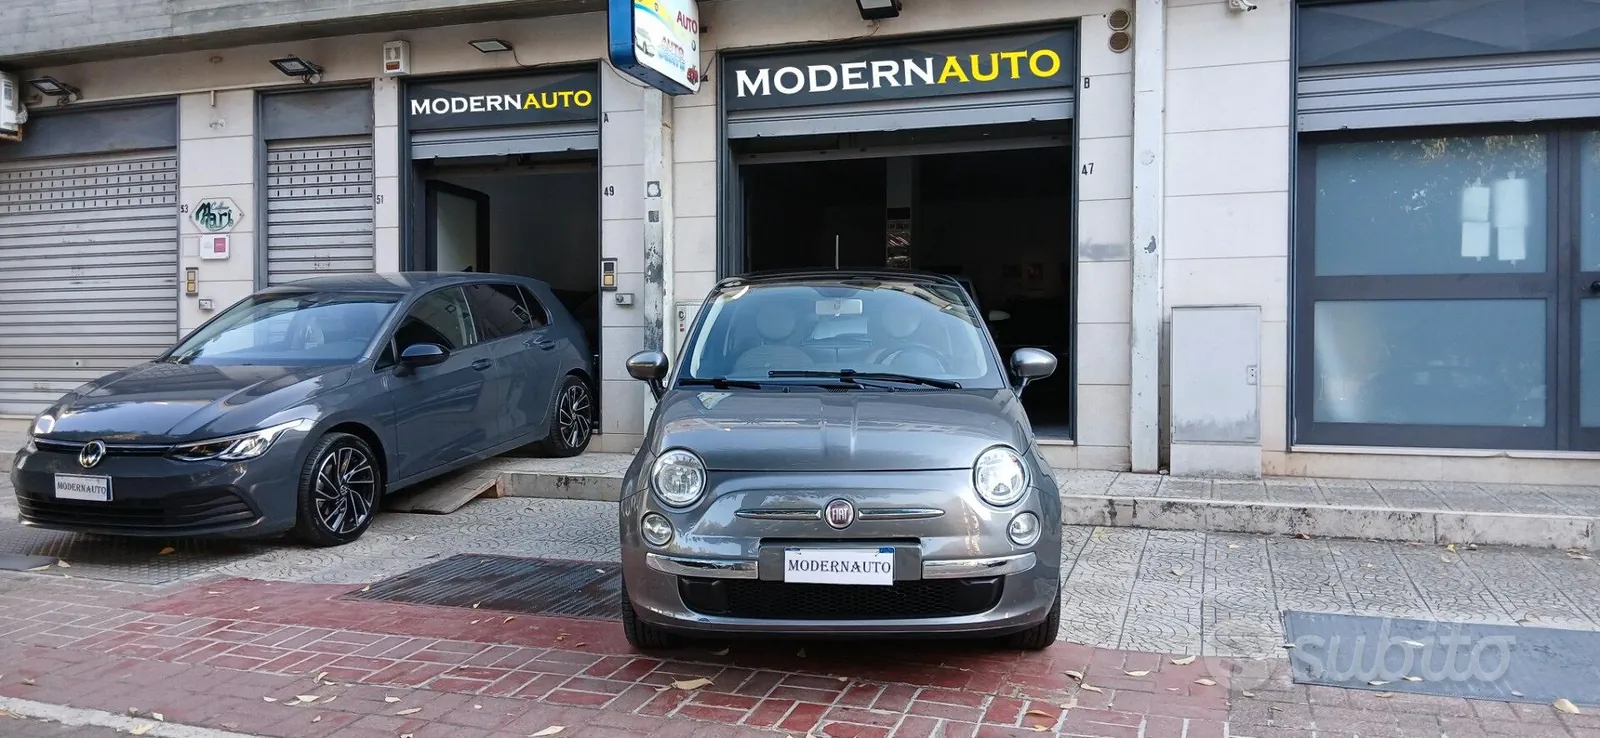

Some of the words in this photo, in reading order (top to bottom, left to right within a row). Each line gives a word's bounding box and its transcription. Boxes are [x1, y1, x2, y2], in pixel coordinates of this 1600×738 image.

[677, 10, 698, 35] AUTO
[735, 49, 1061, 98] MODERNAUTO
[1083, 77, 1091, 89] B
[410, 90, 593, 116] MODERNAUTO
[603, 112, 609, 123] A
[1081, 162, 1094, 176] 47
[603, 185, 615, 197] 49
[376, 194, 384, 205] 51
[180, 204, 189, 214] 53
[56, 481, 107, 495] MODERNAUTO
[831, 507, 849, 521] FIAT
[788, 559, 891, 574] MODERNAUTO
